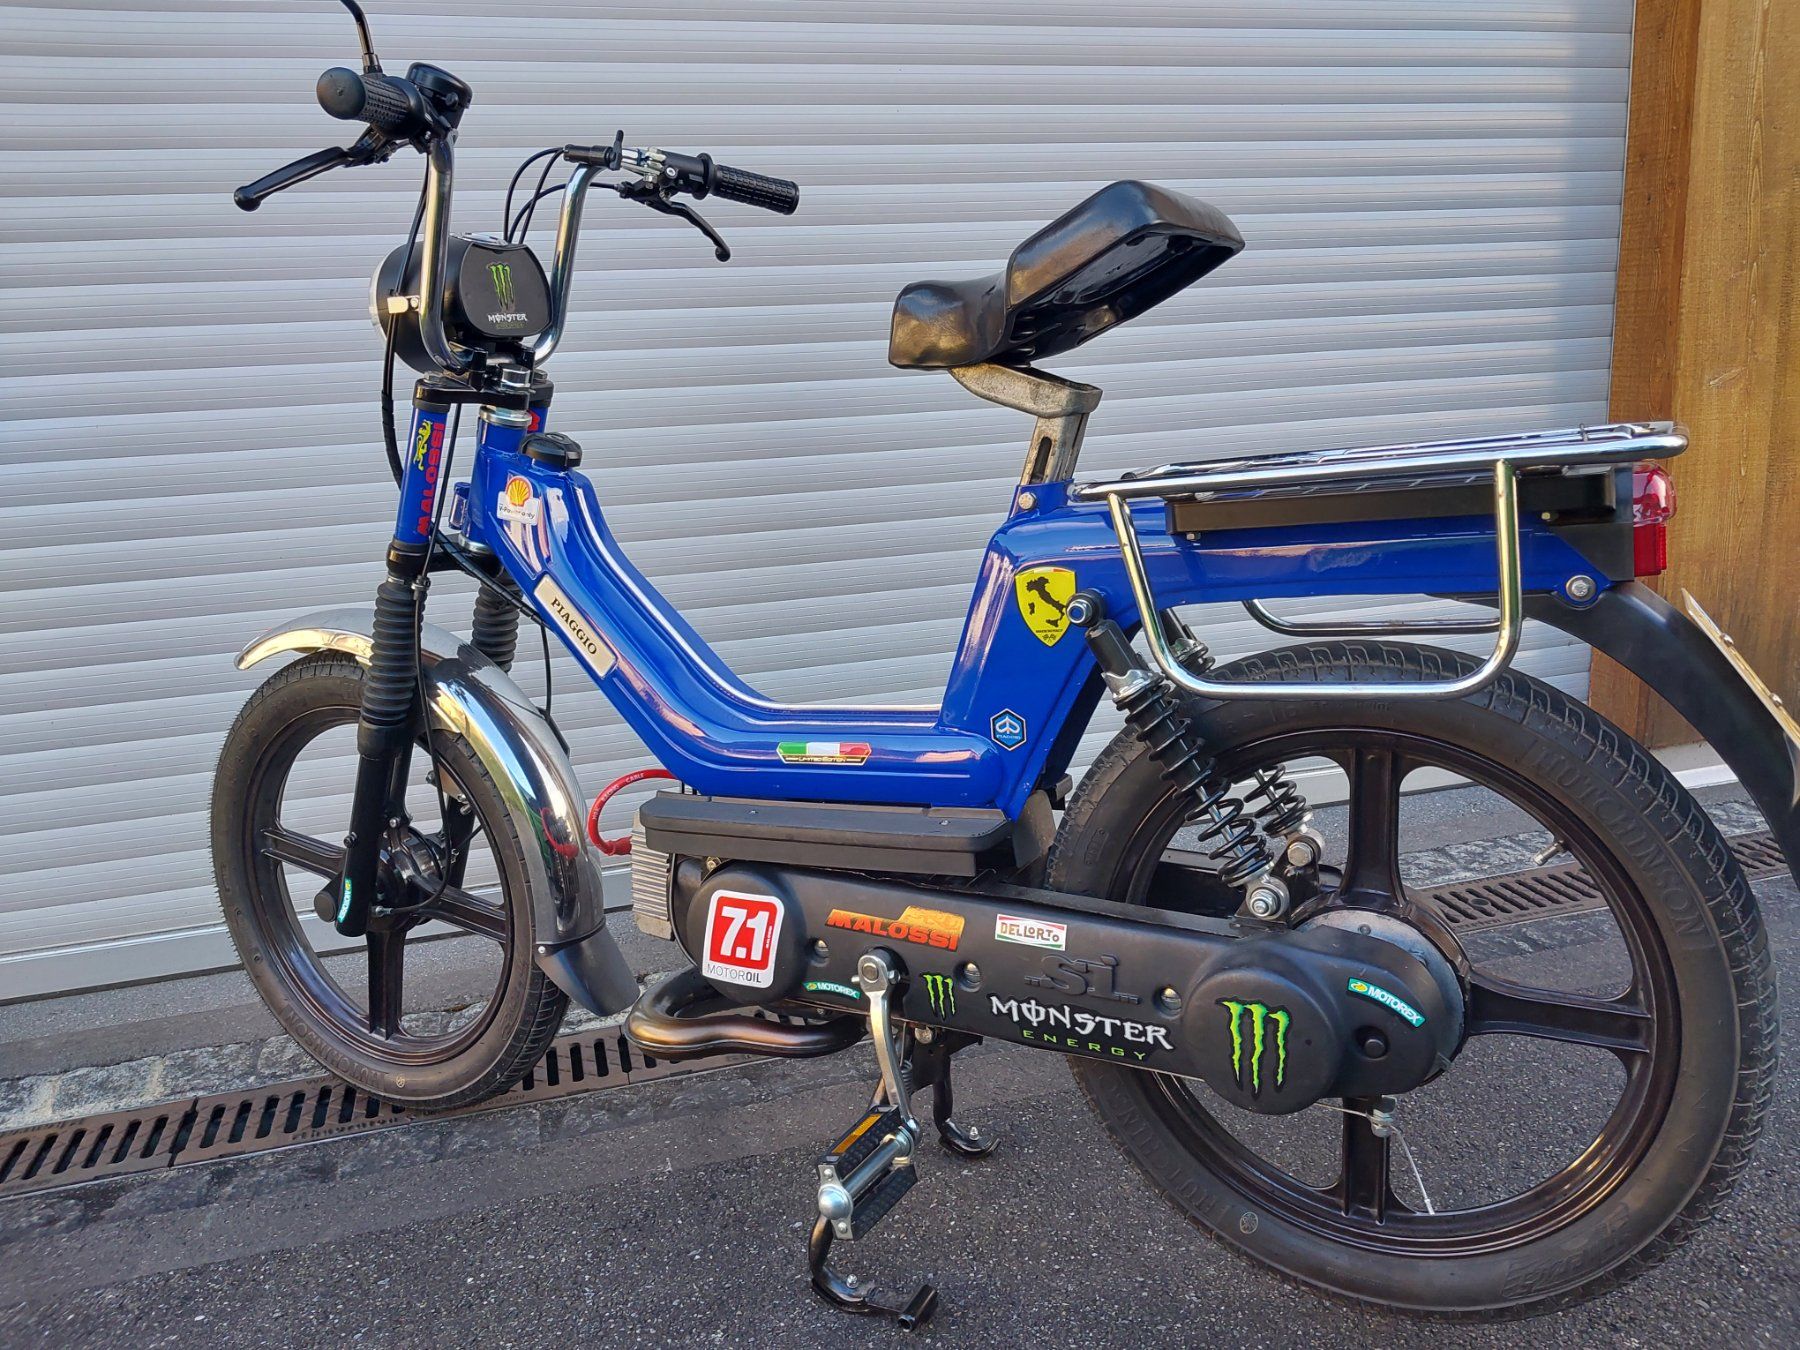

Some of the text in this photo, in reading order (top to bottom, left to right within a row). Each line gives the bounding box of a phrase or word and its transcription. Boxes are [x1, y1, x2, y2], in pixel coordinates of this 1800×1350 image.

[488, 313, 528, 323] MONSTER
[417, 422, 445, 536] MALOSSI
[551, 597, 598, 656] PIAGGIO
[625, 772, 645, 783] CABLE
[720, 906, 770, 961] 7.1
[827, 912, 960, 950] MALOSSI
[818, 982, 859, 997] MOTOREX
[1367, 985, 1422, 1024] MOTOREX
[989, 995, 1174, 1050] MONSTER
[1022, 1029, 1147, 1061] ENERGY
